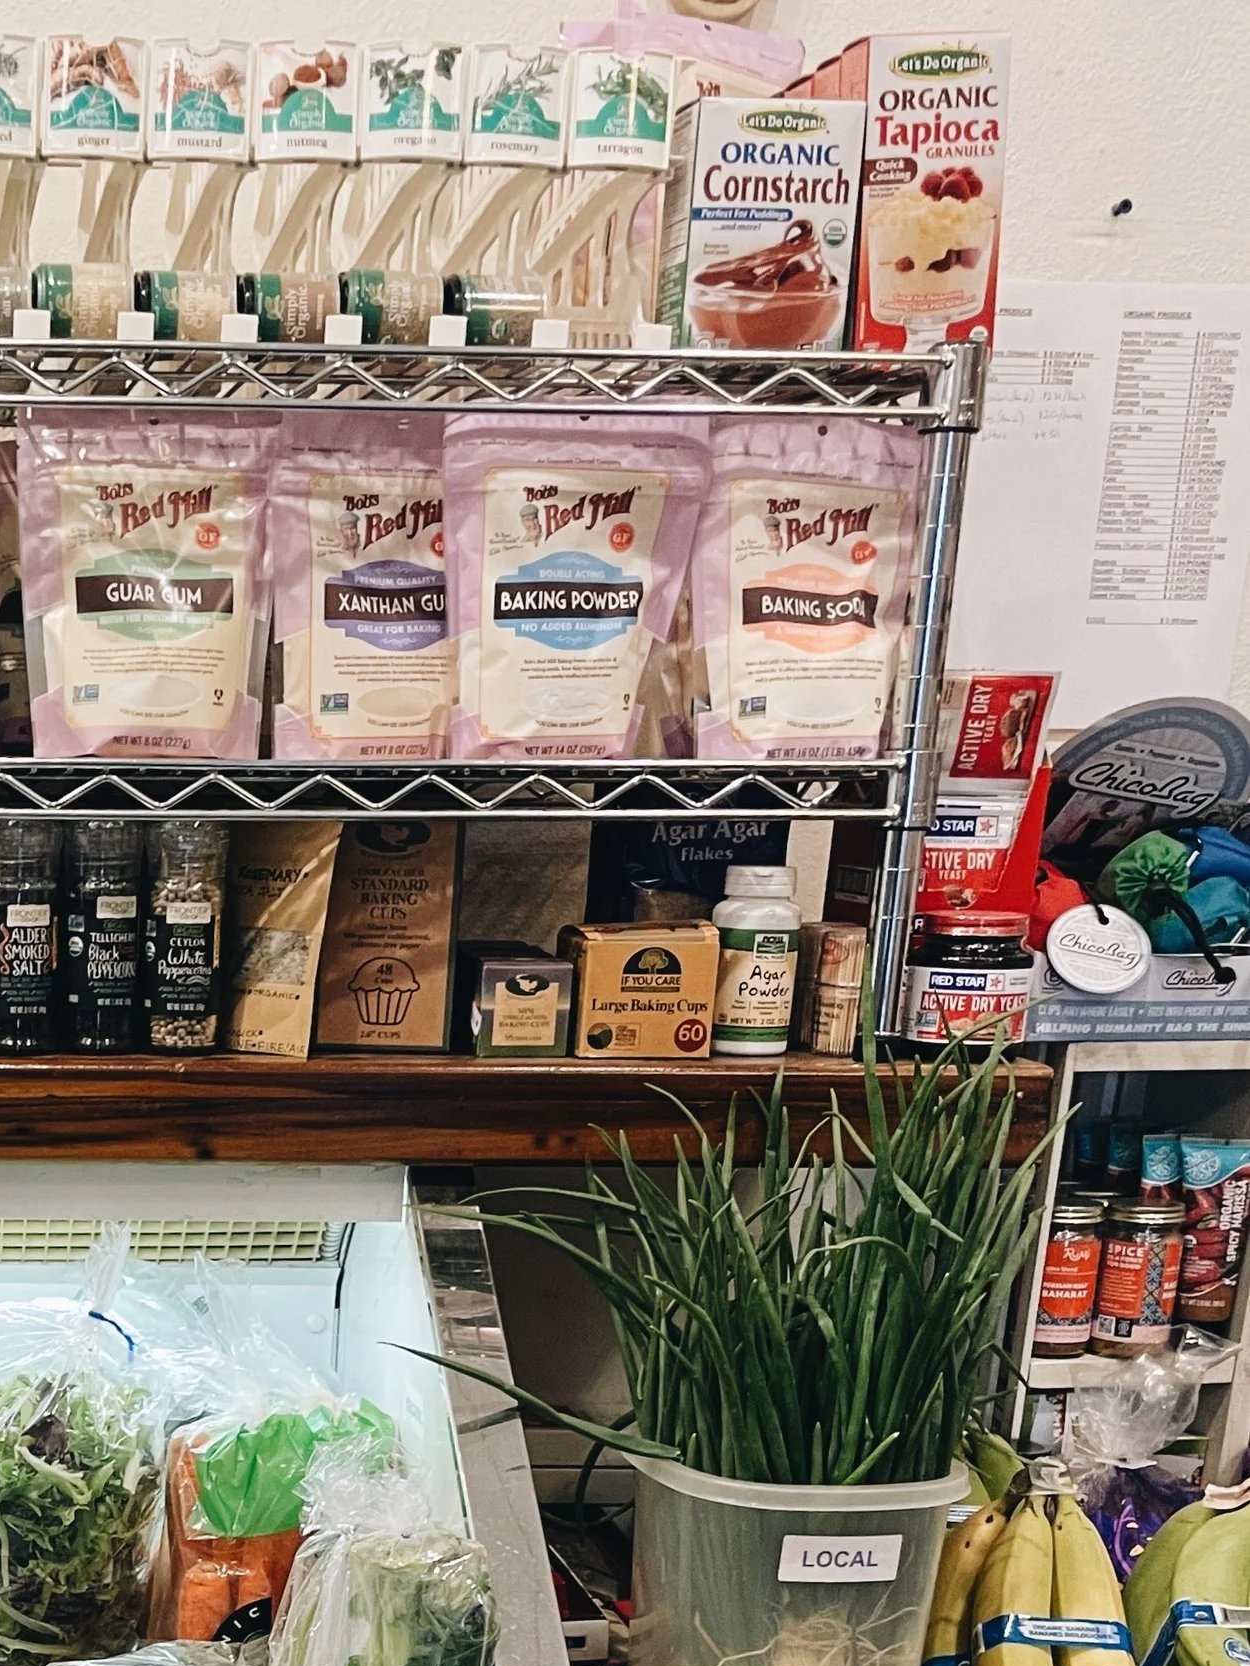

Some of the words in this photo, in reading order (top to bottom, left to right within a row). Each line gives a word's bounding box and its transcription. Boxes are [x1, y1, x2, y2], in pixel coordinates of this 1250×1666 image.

[924, 57, 939, 70] Do
[941, 54, 990, 71] Organic
[878, 86, 999, 112] ORGANIC
[767, 118, 782, 128] Do
[783, 117, 827, 132] Organic
[78, 136, 110, 147] ginger
[177, 135, 222, 147] mustard
[874, 113, 1000, 154] Tapioca
[286, 136, 327, 149] nutmeg
[490, 140, 539, 154] rosemary
[597, 143, 643, 155] tarragon
[721, 141, 840, 166] ORGANIC
[926, 144, 995, 159] GRANULES
[875, 159, 905, 172] Quick
[869, 170, 911, 182] Cooking
[703, 165, 850, 205] Cornstarch
[700, 208, 732, 220] Perfect
[749, 209, 789, 221] Puddings
[523, 485, 559, 503] Bob's
[343, 494, 380, 512] Bob's
[119, 499, 165, 539] Red
[167, 485, 214, 528] Mill
[543, 493, 585, 541] Red
[585, 485, 637, 530] Mill
[362, 502, 408, 550] Red
[786, 510, 825, 552] Red
[825, 503, 875, 546] Mill
[354, 575, 393, 586] PREMIUM
[396, 575, 437, 586] QUALITY
[539, 568, 573, 579] DOUBLE
[575, 569, 605, 580] ACTING
[106, 582, 155, 603] GUAR
[160, 585, 202, 605] GUM
[500, 591, 567, 611] BAKING
[571, 590, 639, 610] POWDER
[339, 592, 415, 614] XANTHAN
[421, 594, 445, 612] GU
[761, 595, 821, 618] BAKING
[826, 597, 866, 620] SODA
[357, 624, 384, 634] GREAT
[386, 624, 404, 634] FOR
[406, 624, 441, 634] BAKING
[521, 623, 538, 633] NO
[541, 622, 572, 632] ADDED
[971, 683, 994, 706] DRY
[983, 714, 998, 744] YEAST
[957, 709, 986, 772] ACTIVE
[1074, 761, 1216, 814] ChicoBag
[652, 821, 708, 846] Agar
[714, 820, 769, 845] Agar
[941, 820, 974, 833] STAR
[681, 847, 734, 862] Flakes
[966, 851, 995, 870] DRY
[238, 867, 301, 883] ROSEMARY
[938, 869, 967, 880] YEAST
[351, 877, 429, 892] STANDARD
[361, 893, 418, 906] BAKING
[369, 906, 407, 920] CUPS
[9, 928, 47, 944] ALDER
[170, 937, 205, 947] CEYLON
[5, 944, 50, 960] SMOKED
[89, 944, 119, 961] Black
[168, 948, 205, 965] White
[1059, 933, 1142, 966] ChicoBag
[12, 960, 42, 976] SALT
[376, 963, 393, 975] 48
[749, 965, 786, 985] Agar
[621, 976, 629, 986] IF
[630, 976, 653, 986] YOU
[655, 976, 682, 986] CARE
[931, 974, 954, 987] RED
[955, 974, 985, 987] STAR
[739, 981, 789, 997] Powder
[591, 999, 629, 1015] Large
[631, 999, 675, 1015] Baking
[677, 1000, 708, 1015] Cups
[922, 994, 968, 1012] ACTIVE
[971, 994, 998, 1012] DRY
[677, 1025, 703, 1042] 60
[1036, 1023, 1090, 1034] HELPING
[1095, 1023, 1161, 1034] HUMANITY
[1219, 1180, 1237, 1230] ORGANIC
[1231, 1180, 1249, 1228] HARISSA
[1108, 1243, 1145, 1257] SPICE
[1226, 1231, 1240, 1262] SPICY
[1042, 1290, 1088, 1298] BAHARAT
[801, 1549, 879, 1568] LOCAL
